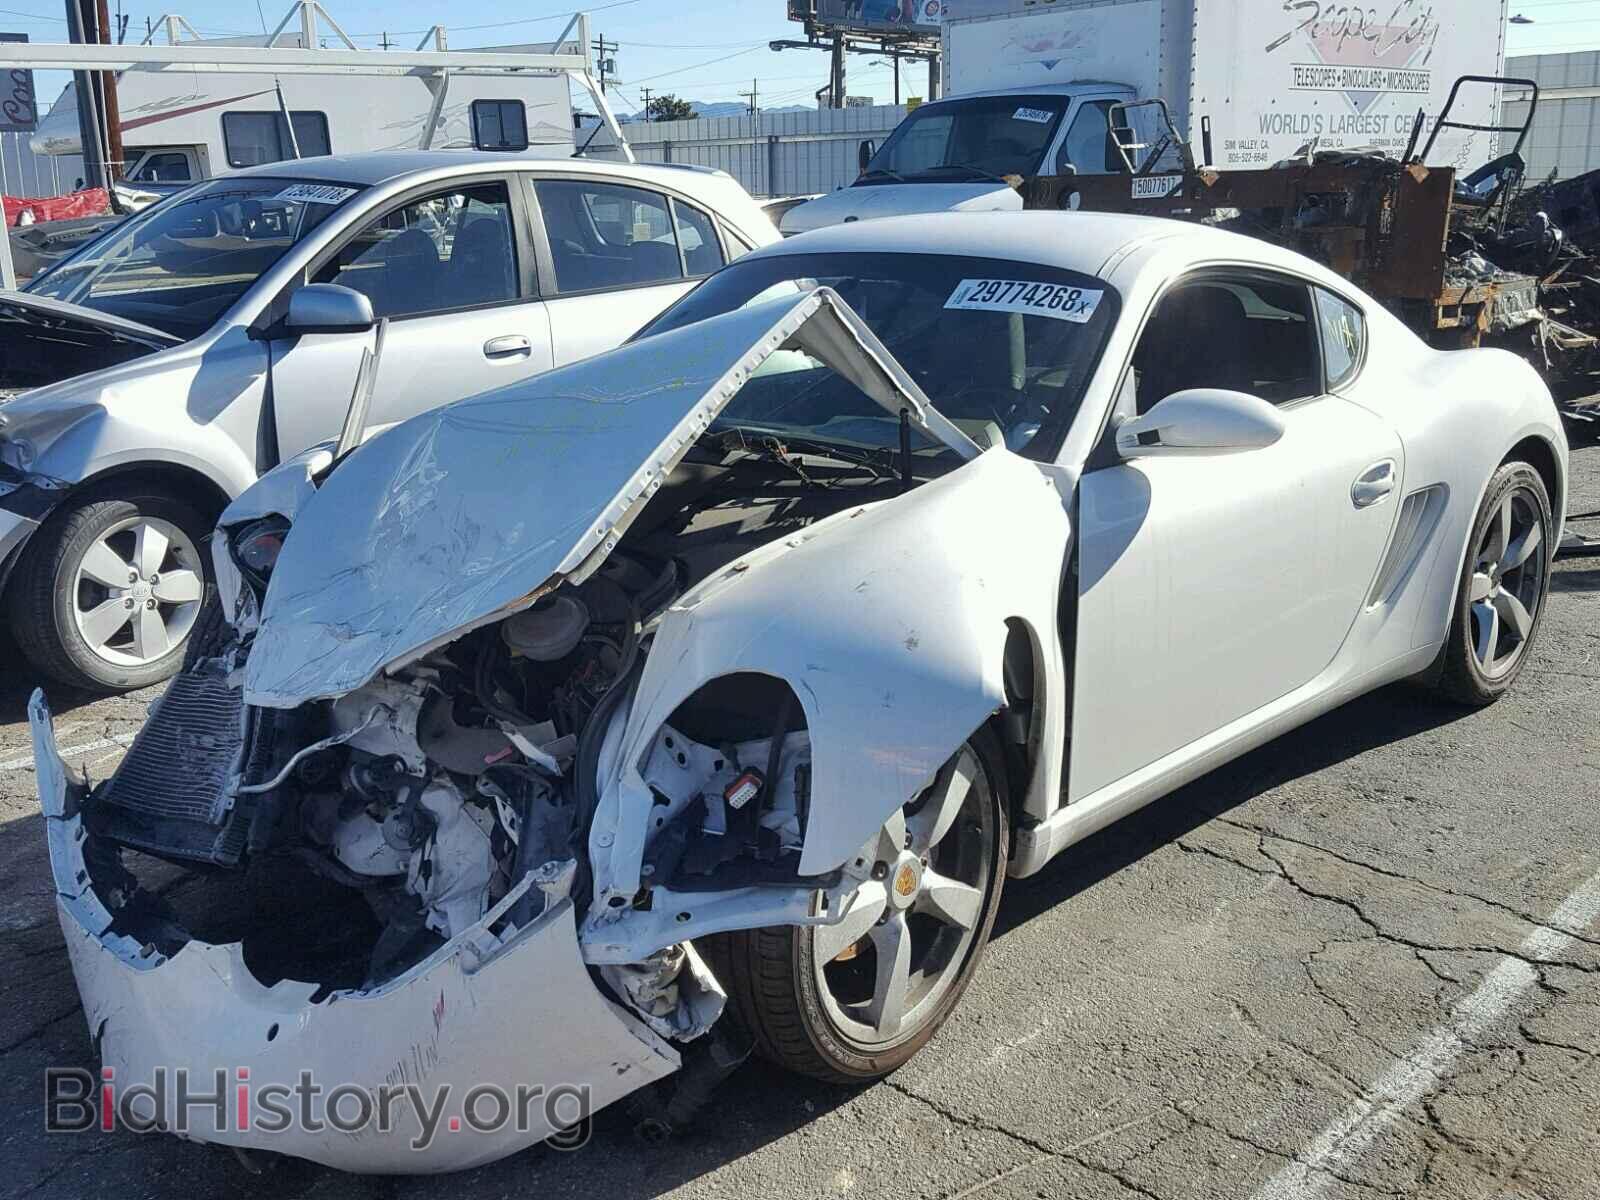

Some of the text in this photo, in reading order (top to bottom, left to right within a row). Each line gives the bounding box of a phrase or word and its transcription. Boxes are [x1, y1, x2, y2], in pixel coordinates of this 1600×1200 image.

[1265, 0, 1440, 66] Scope City
[1293, 67, 1430, 91] TELESCOPES BINOCULARS MICROSCOPES
[1259, 113, 1323, 134] WORLD'S
[1329, 114, 1389, 134] LARGEST
